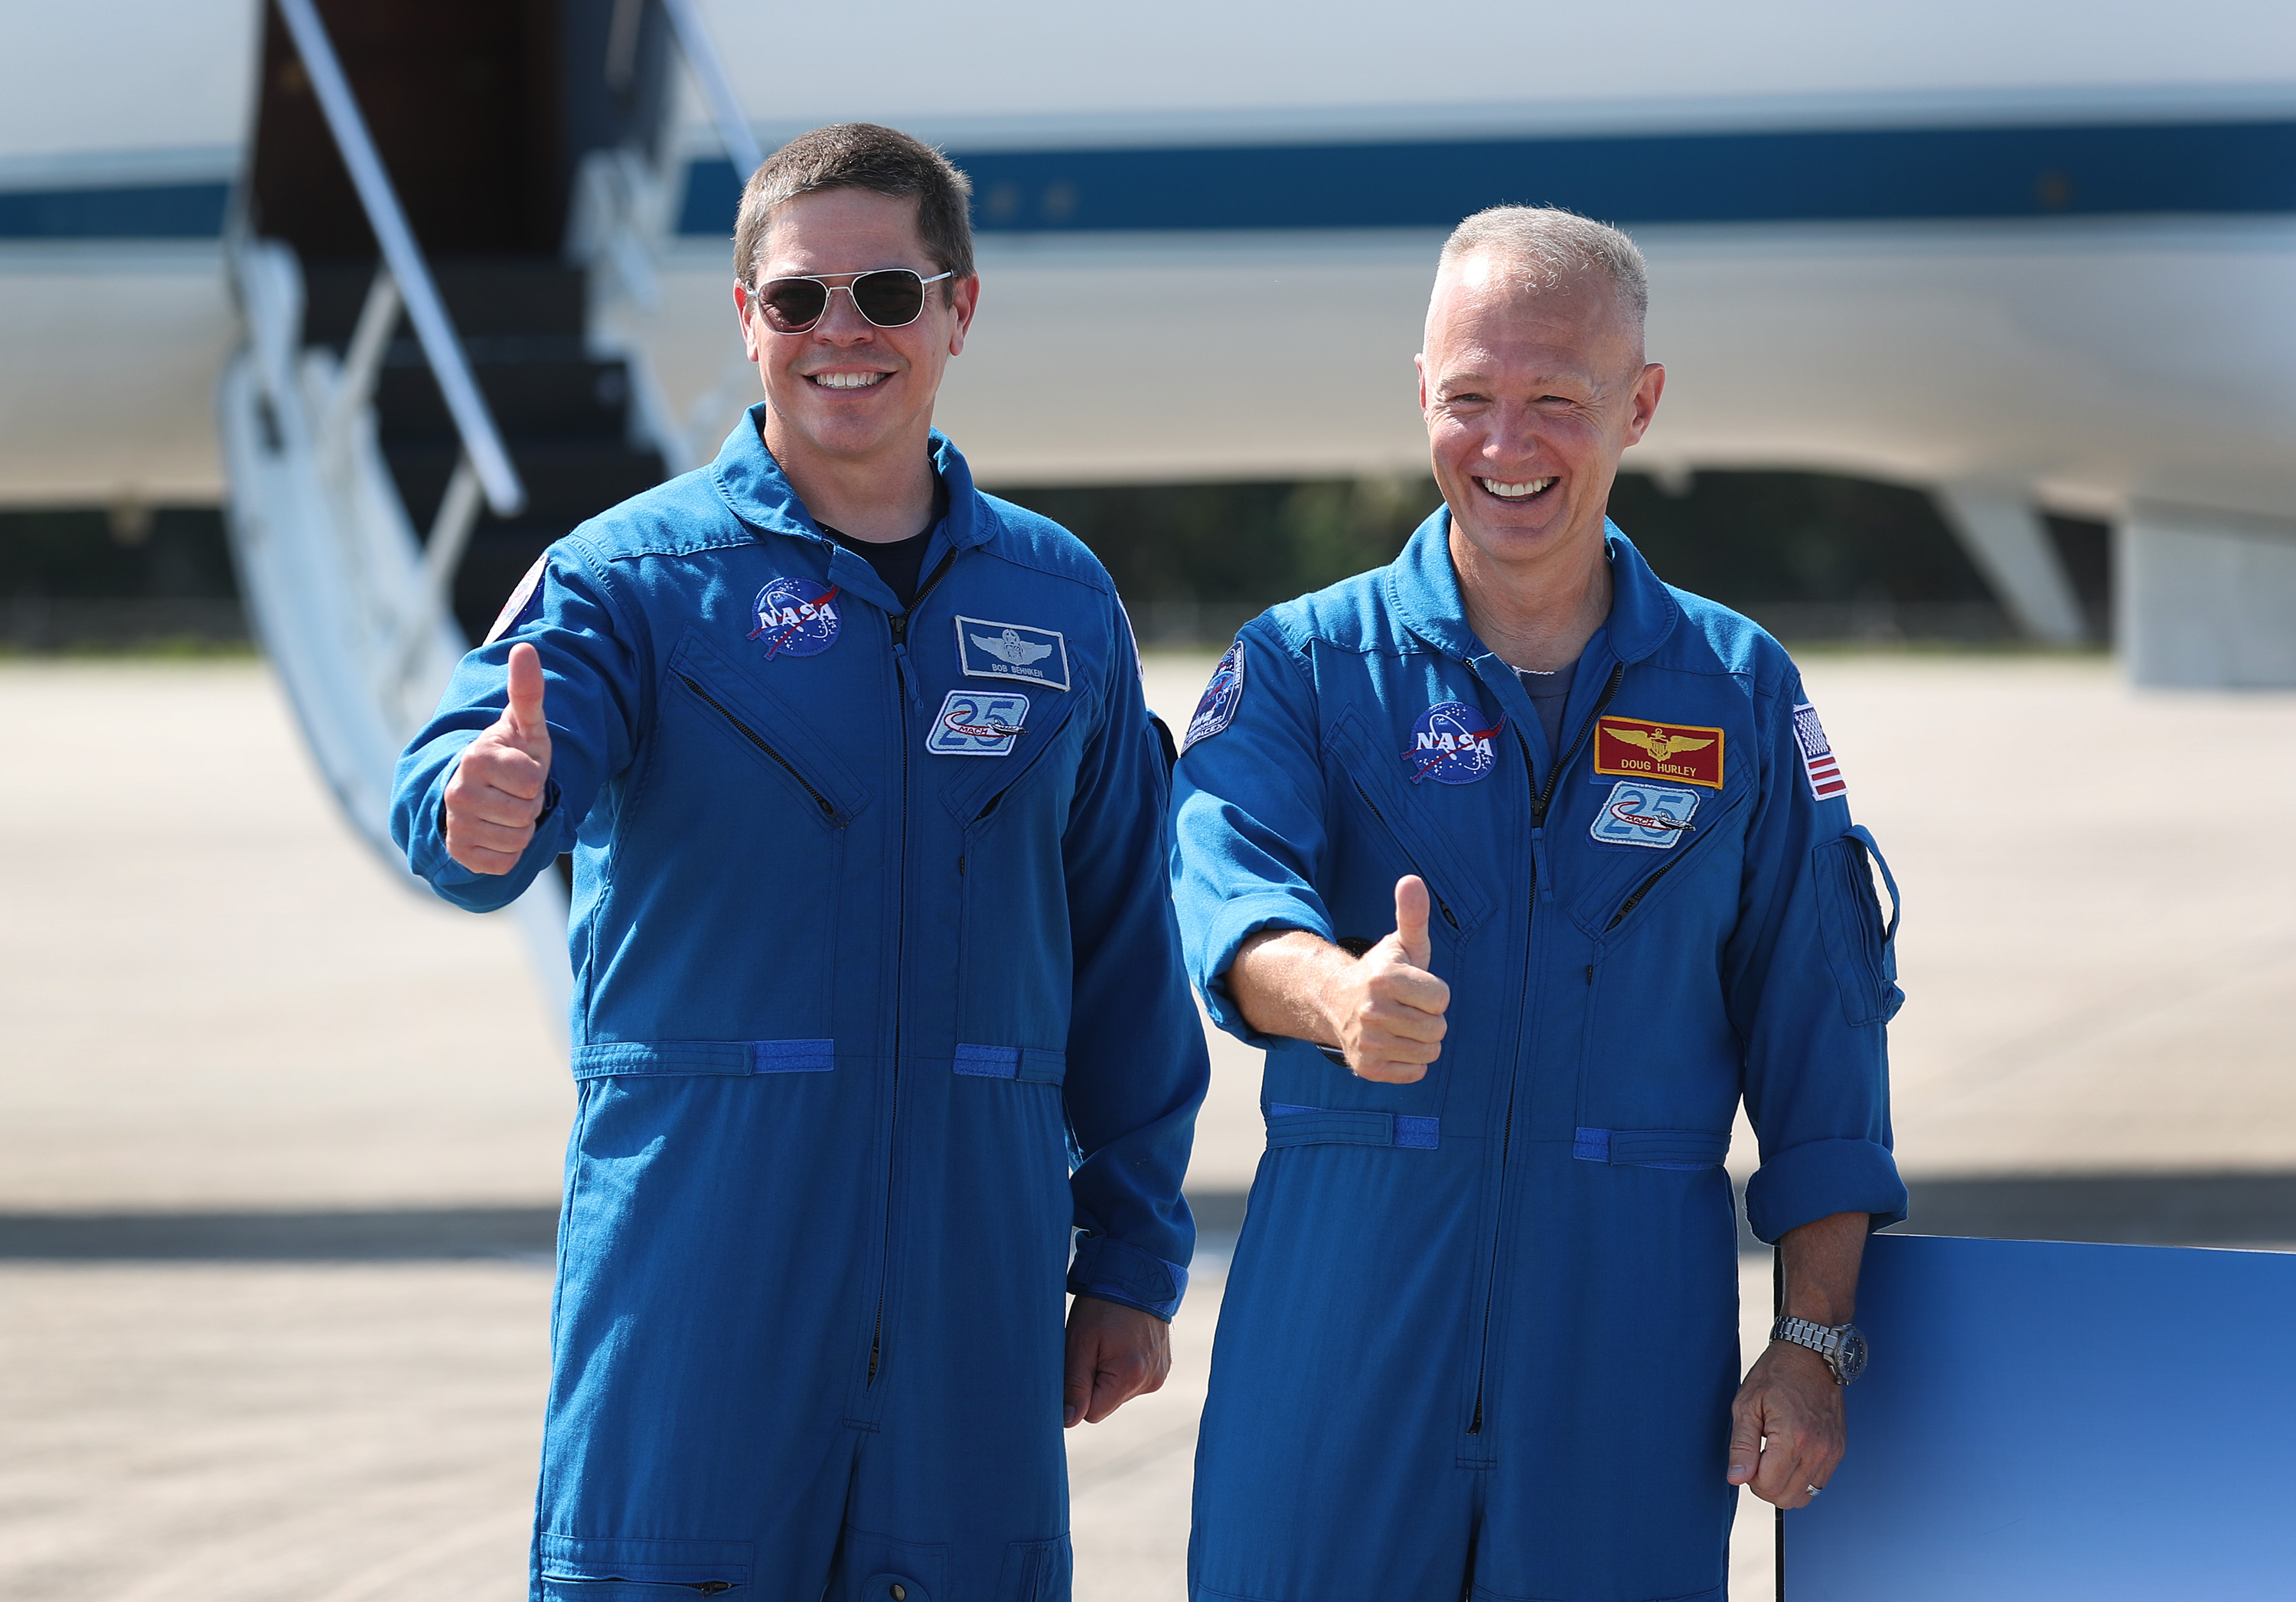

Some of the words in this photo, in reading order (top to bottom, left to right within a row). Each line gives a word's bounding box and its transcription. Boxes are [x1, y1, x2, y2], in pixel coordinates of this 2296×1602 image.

[758, 603, 837, 629] NASA
[992, 664, 1007, 672] BOB
[1011, 665, 1043, 678] BEHNKEN
[938, 699, 1014, 746] 25
[959, 726, 988, 735] MACH
[1417, 732, 1494, 757] NASA
[1621, 759, 1652, 770] DOUG
[1657, 763, 1697, 777] HURLEY
[1603, 790, 1684, 838] 25
[1625, 816, 1655, 826] MACH
